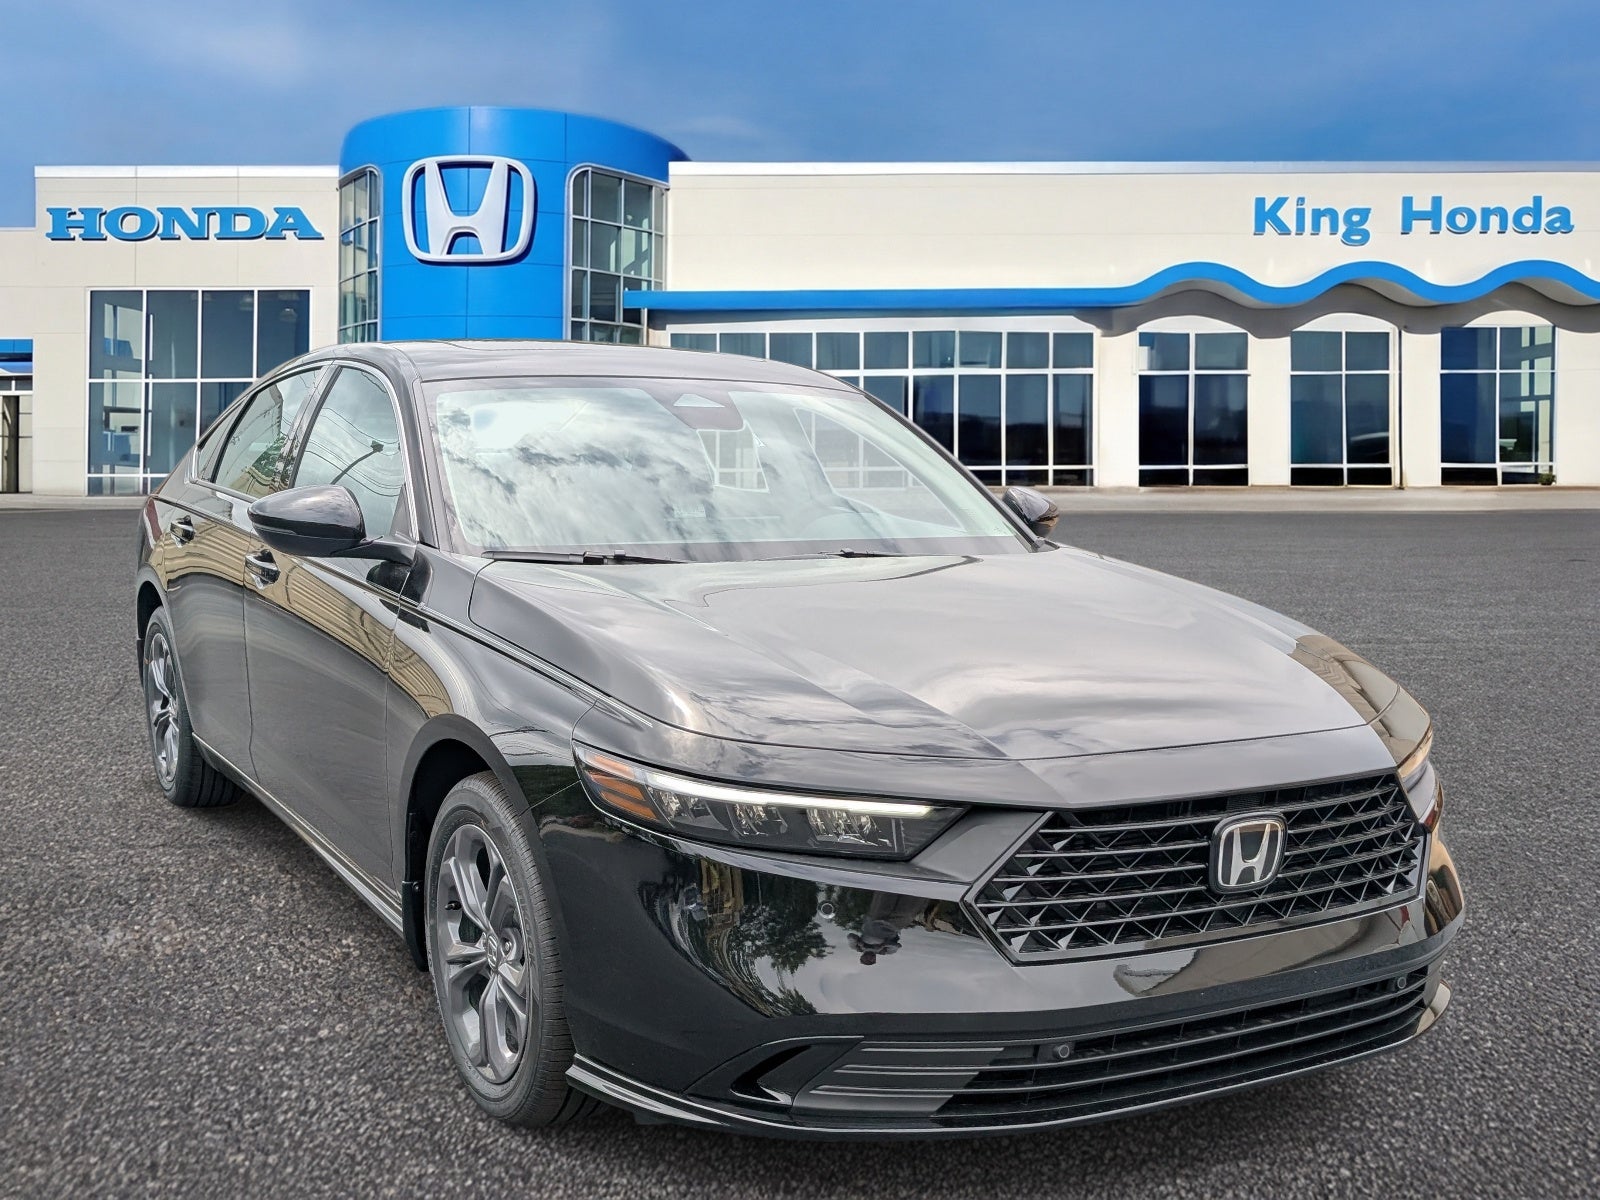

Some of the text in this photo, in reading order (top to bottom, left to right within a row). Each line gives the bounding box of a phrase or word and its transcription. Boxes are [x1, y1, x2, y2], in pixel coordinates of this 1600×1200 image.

[45, 206, 324, 241] HONDA
[1253, 195, 1575, 246] King Honda
